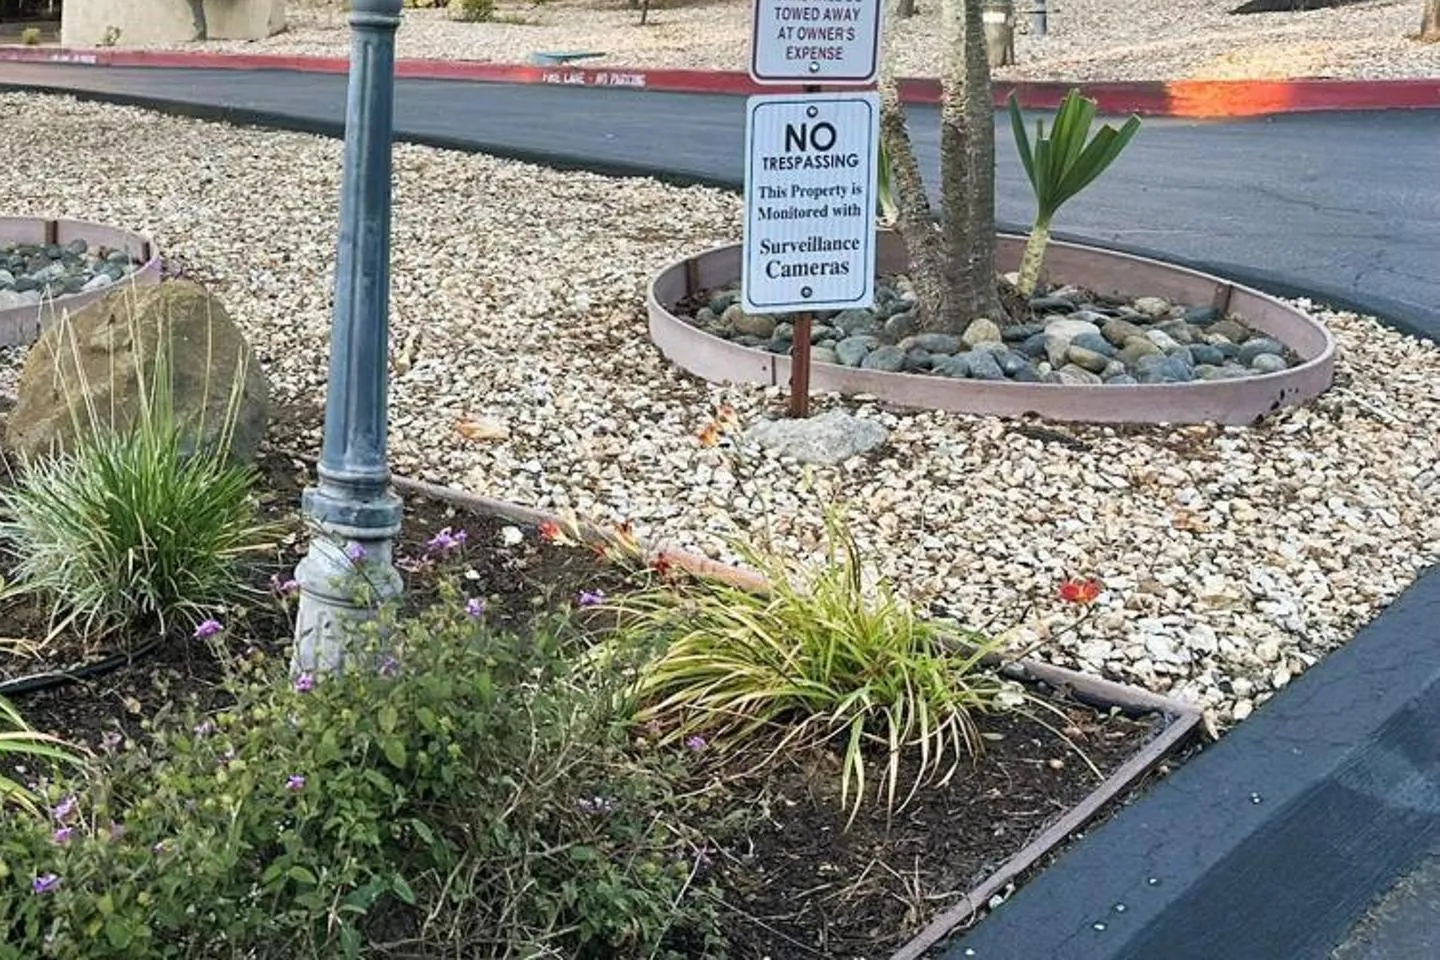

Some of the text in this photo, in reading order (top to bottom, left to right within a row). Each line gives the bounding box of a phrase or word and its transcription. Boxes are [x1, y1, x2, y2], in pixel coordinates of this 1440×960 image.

[774, 7, 861, 21] TOWED AWAY
[777, 26, 794, 40] AT
[786, 45, 844, 60] EXPENSE
[785, 122, 837, 152] NO
[762, 153, 859, 171] TRESPASSING
[758, 182, 863, 200] This Property is
[758, 203, 861, 221] Monitored with
[760, 236, 860, 254] Surveillance
[766, 260, 850, 279] Cameras
